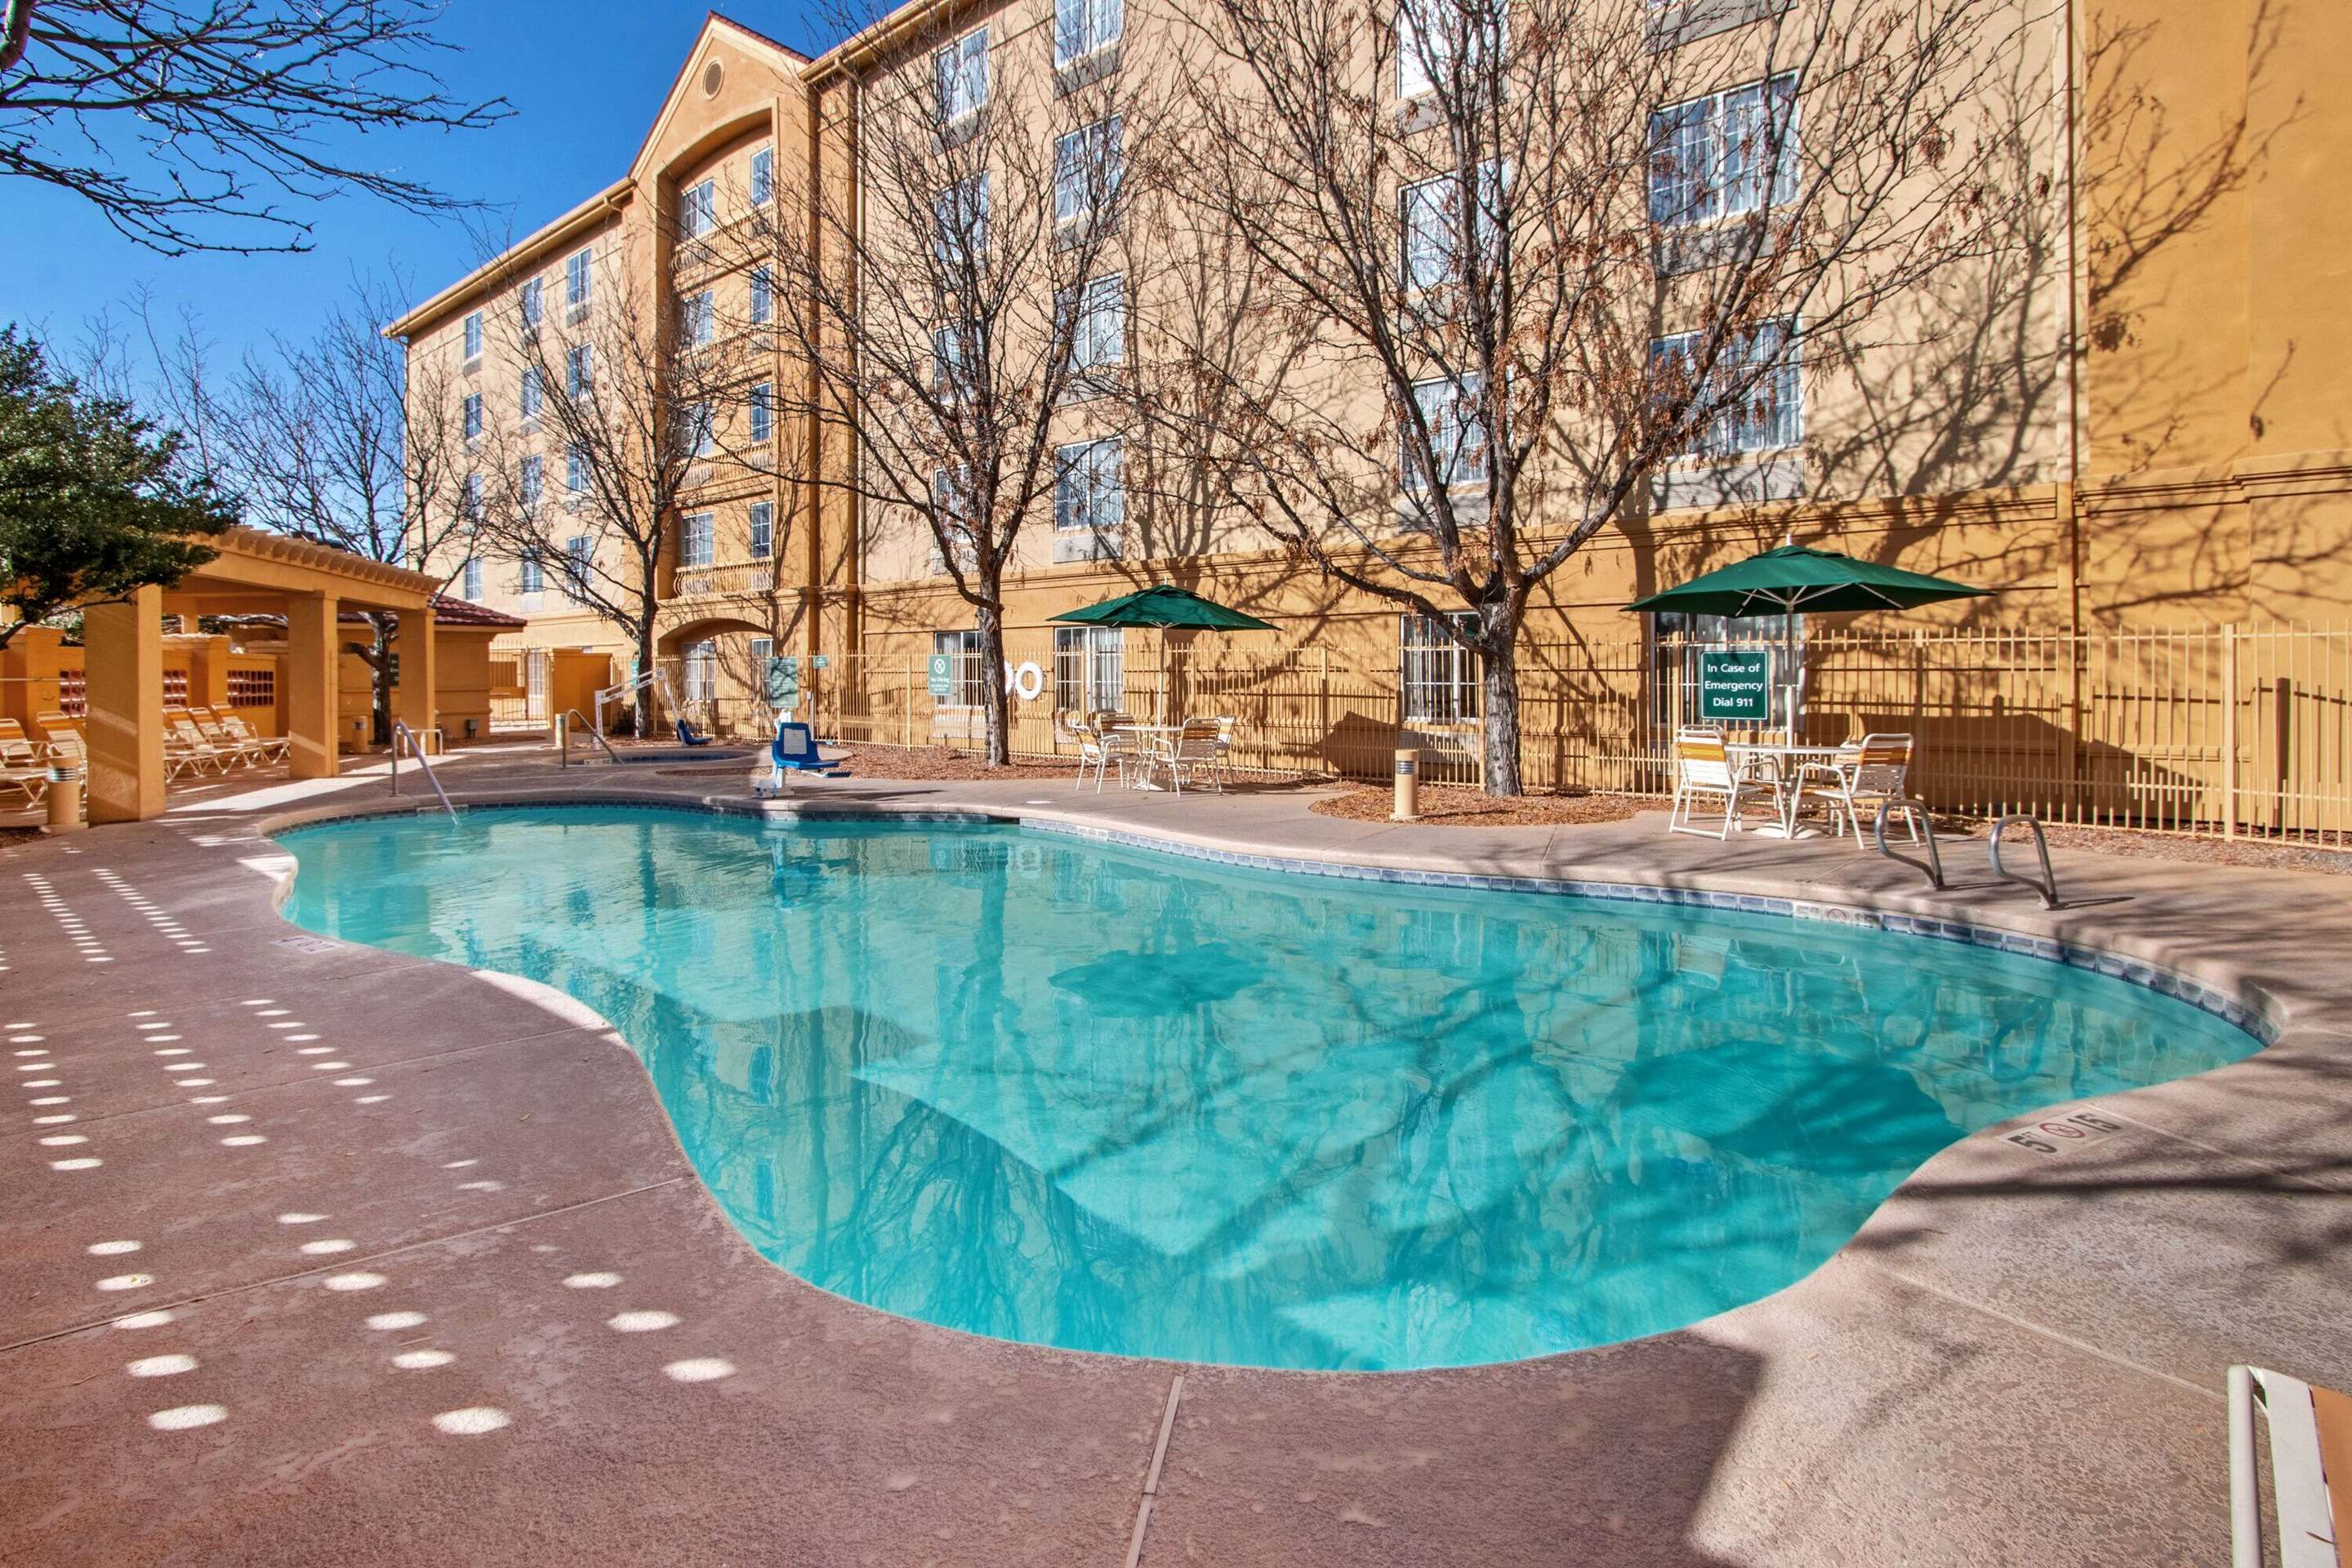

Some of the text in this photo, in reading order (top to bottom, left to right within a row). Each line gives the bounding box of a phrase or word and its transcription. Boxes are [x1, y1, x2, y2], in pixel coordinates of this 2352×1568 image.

[1707, 662, 1762, 673] In Case of
[1704, 680, 1763, 693] Emergency
[1713, 697, 1753, 707] Dial 911
[2007, 1135, 2058, 1153] 5
